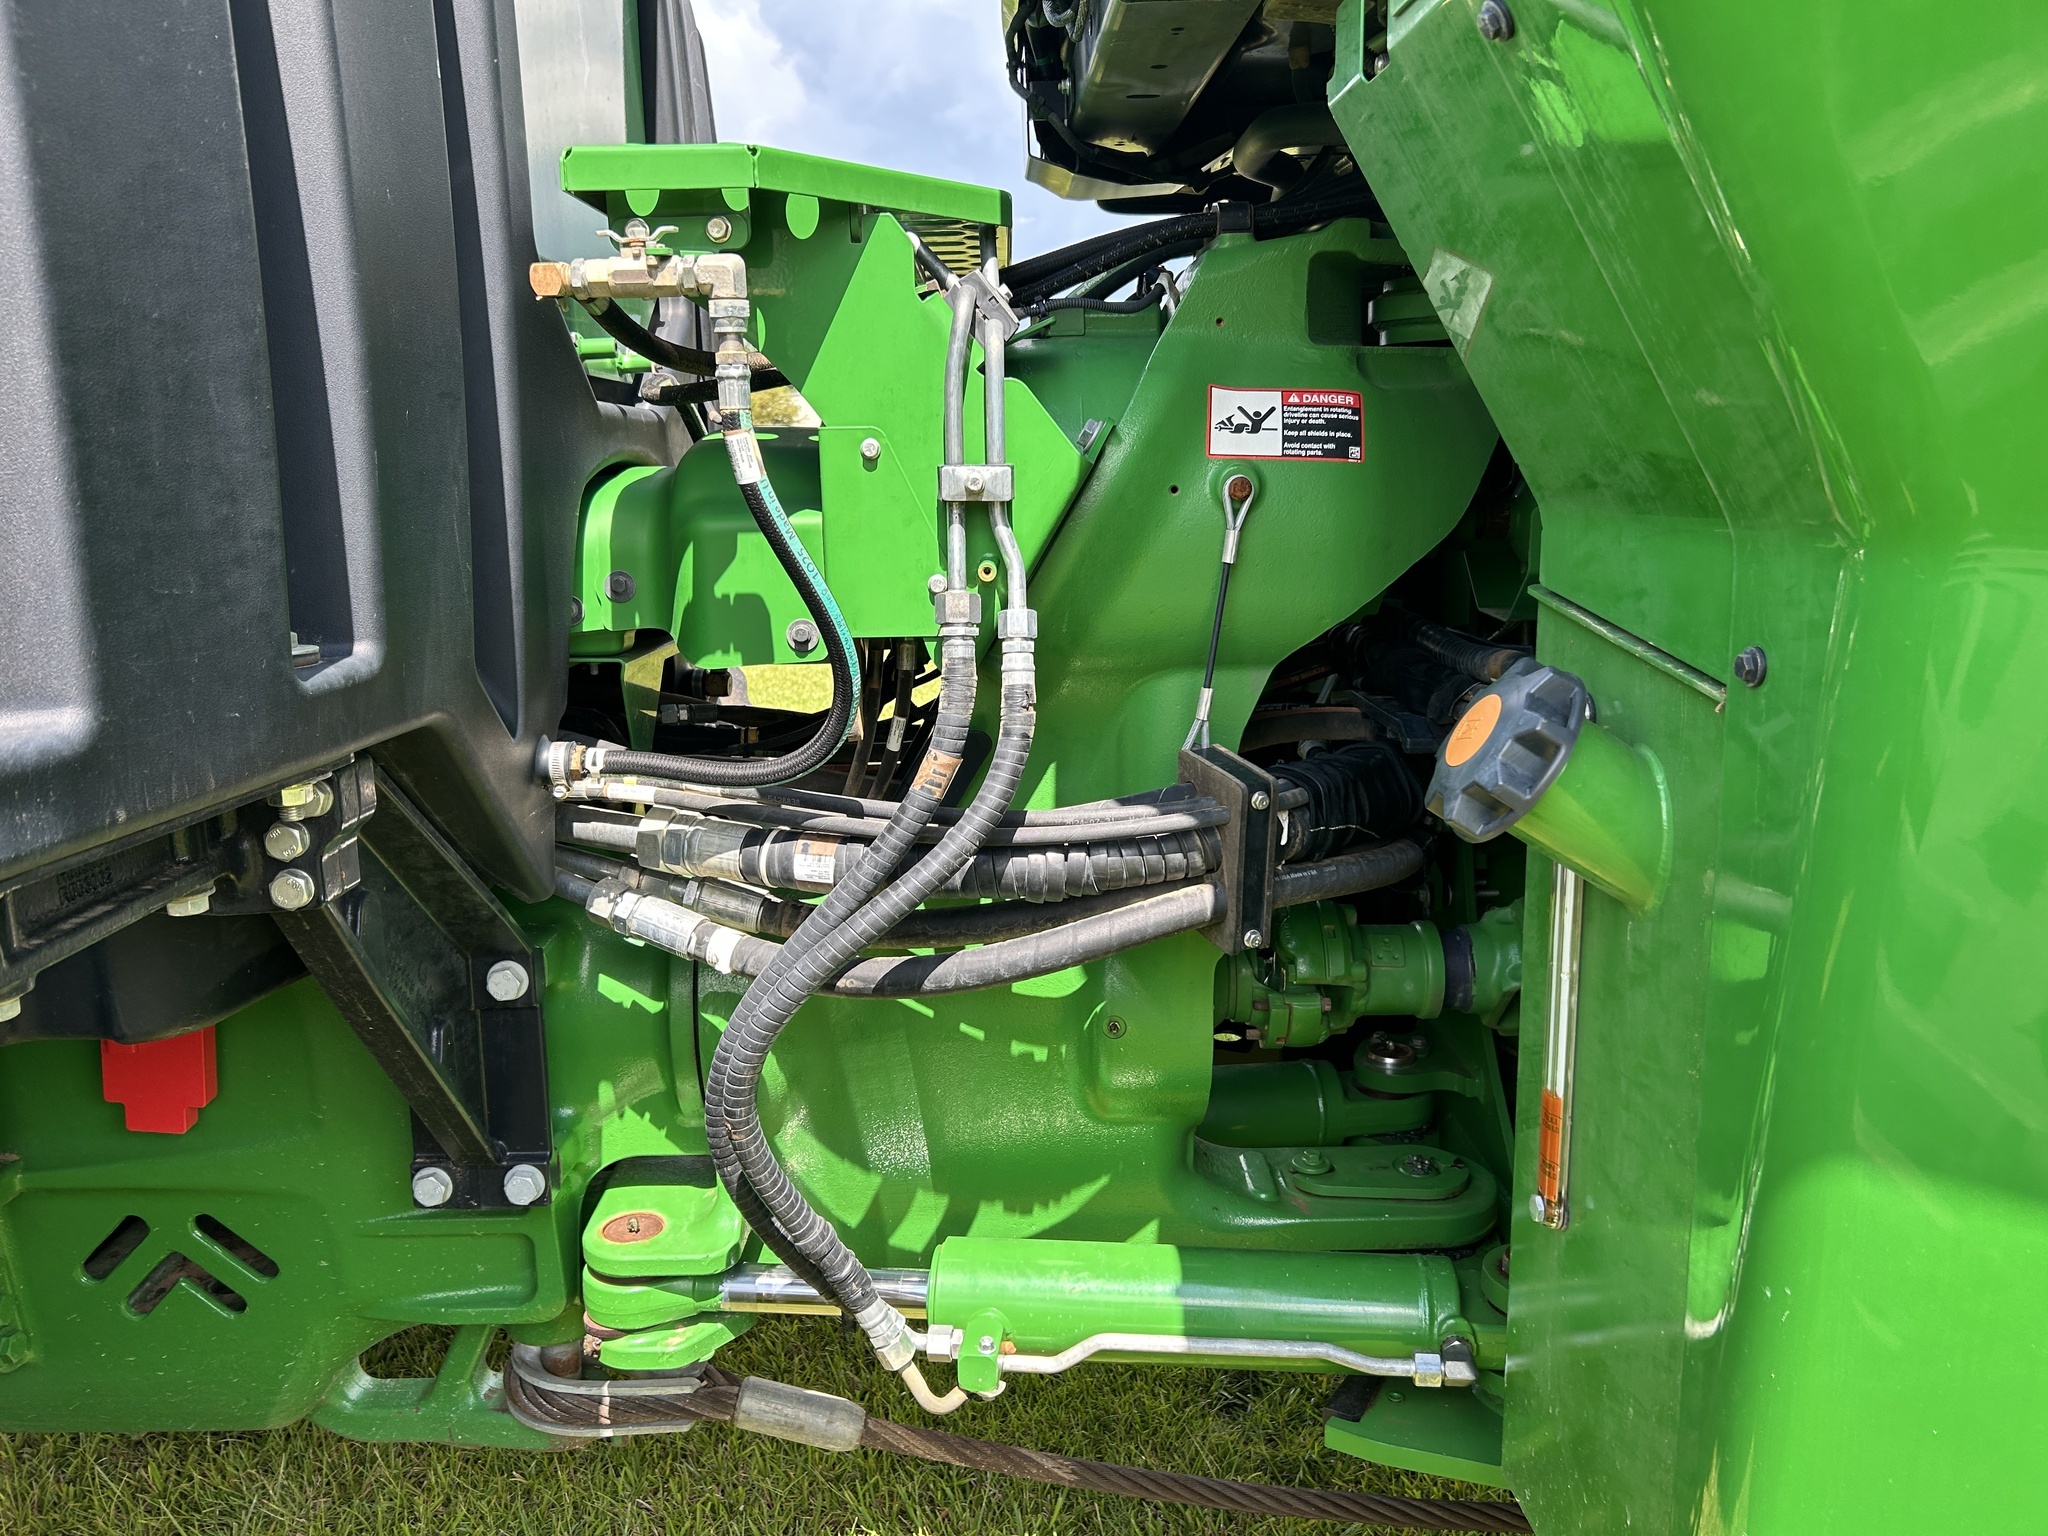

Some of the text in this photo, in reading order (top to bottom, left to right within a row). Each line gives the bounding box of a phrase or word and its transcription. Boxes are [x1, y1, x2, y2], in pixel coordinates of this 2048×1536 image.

[1302, 394, 1354, 405] DANGER
[767, 491, 777, 505] in
[774, 505, 796, 541] Made
